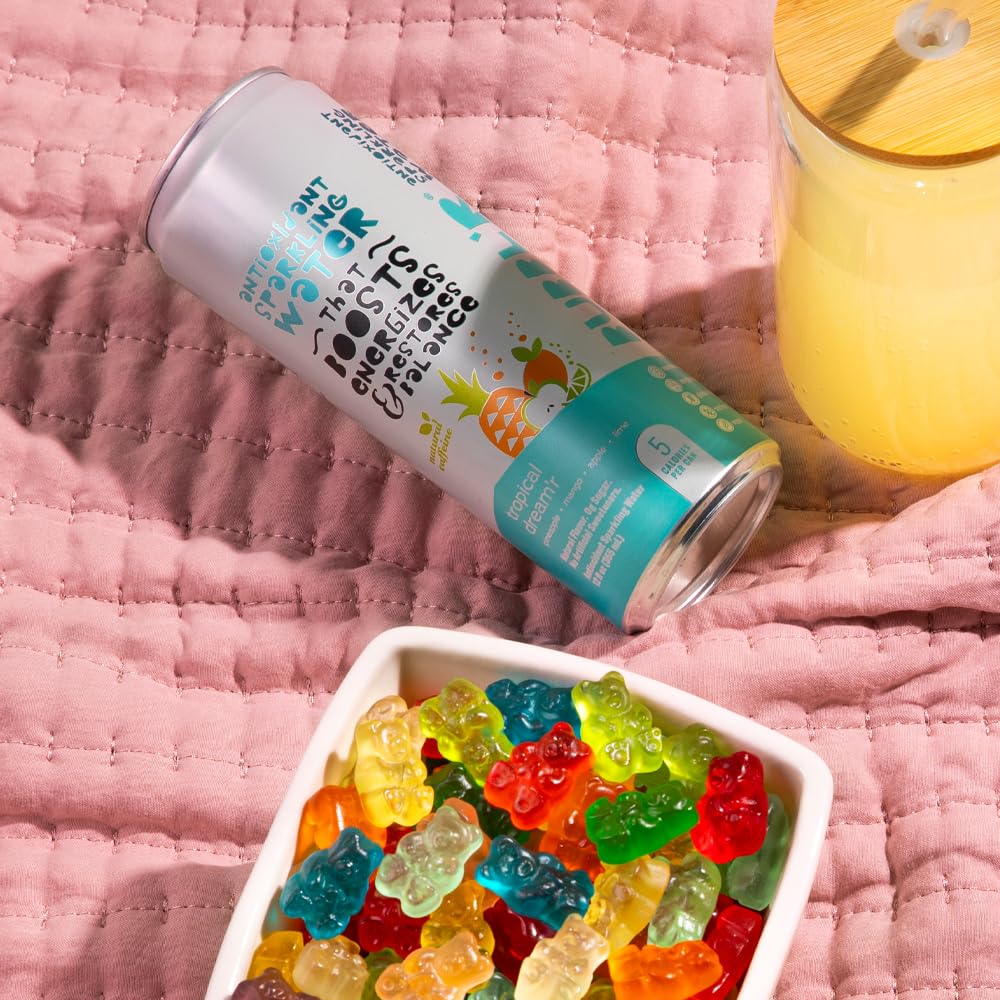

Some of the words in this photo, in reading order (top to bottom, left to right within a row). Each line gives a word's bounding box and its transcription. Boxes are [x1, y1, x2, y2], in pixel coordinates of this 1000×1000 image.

[429, 419, 443, 464] natural
[648, 436, 672, 456] 5
[671, 467, 686, 480] PER
[507, 462, 543, 520] tropical
